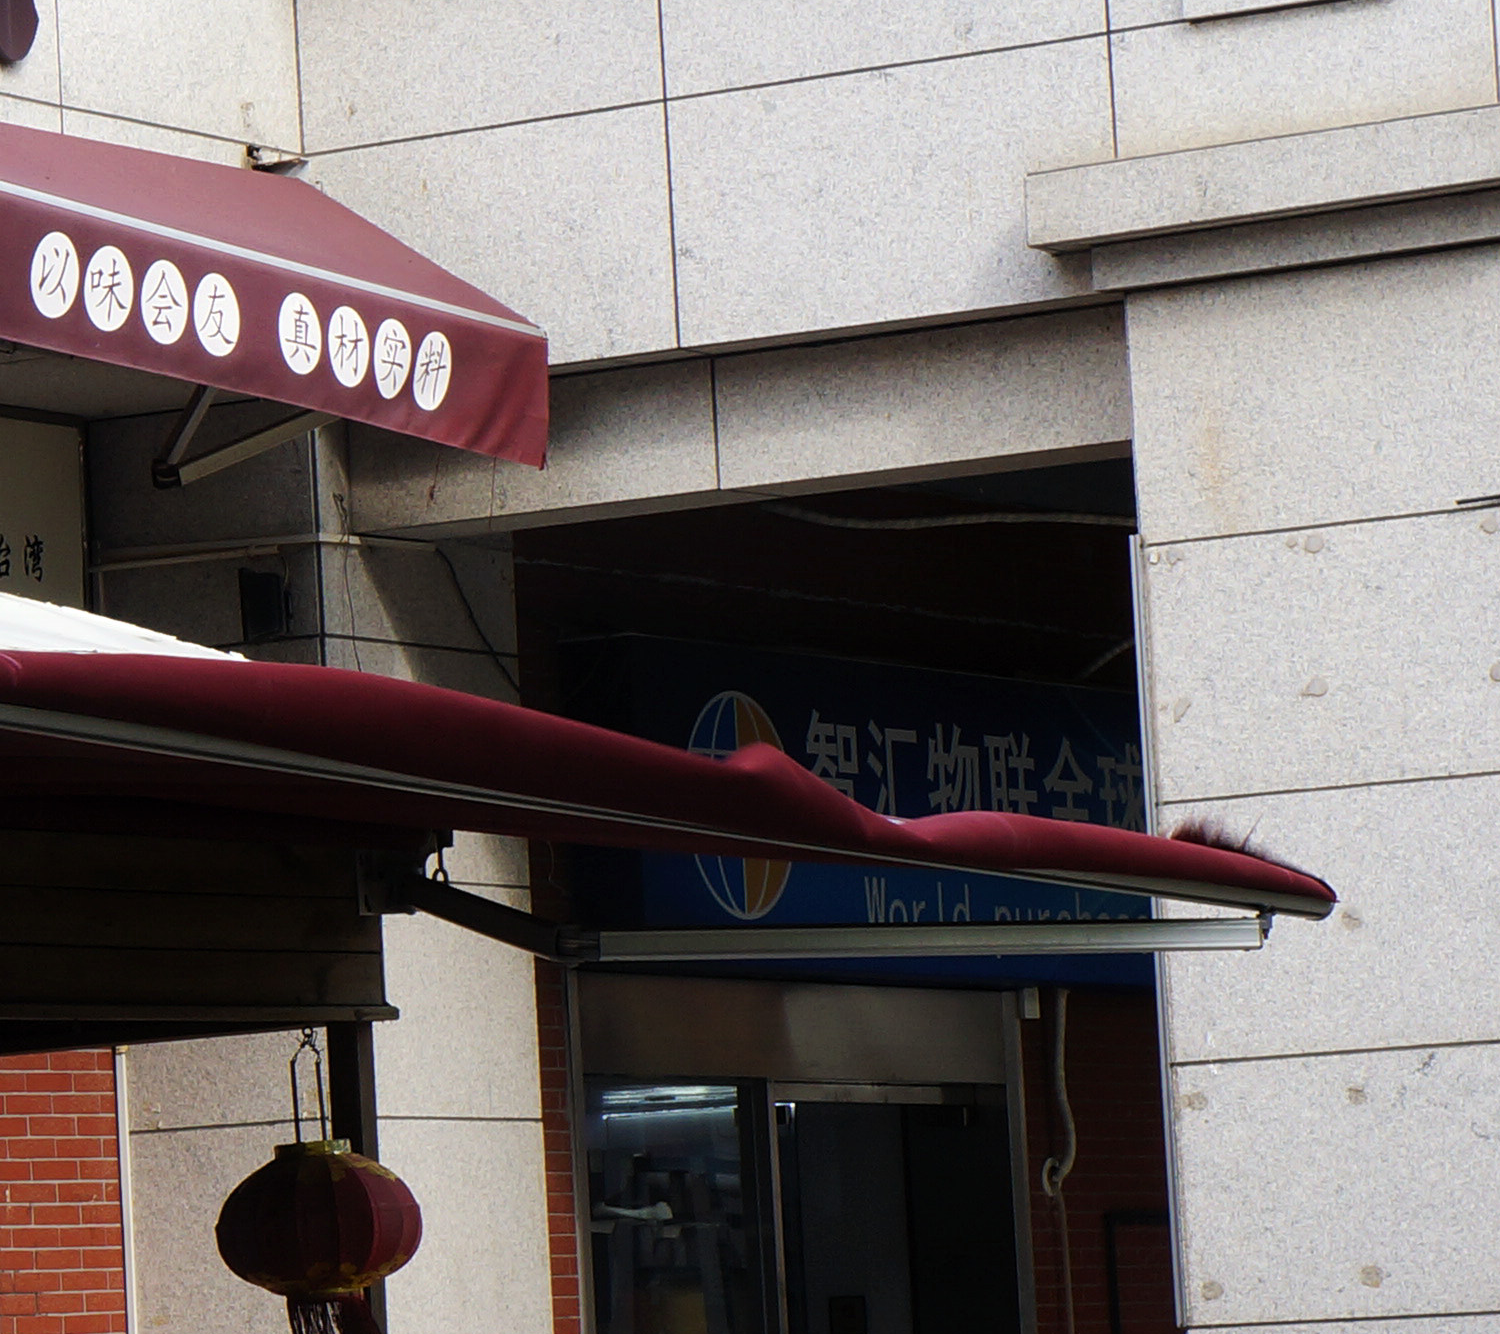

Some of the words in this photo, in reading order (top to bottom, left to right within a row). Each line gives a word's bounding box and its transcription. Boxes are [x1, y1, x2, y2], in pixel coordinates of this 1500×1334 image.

[34, 239, 238, 351] 以味会友
[281, 297, 449, 408] 真材实料
[864, 875, 972, 923] World
